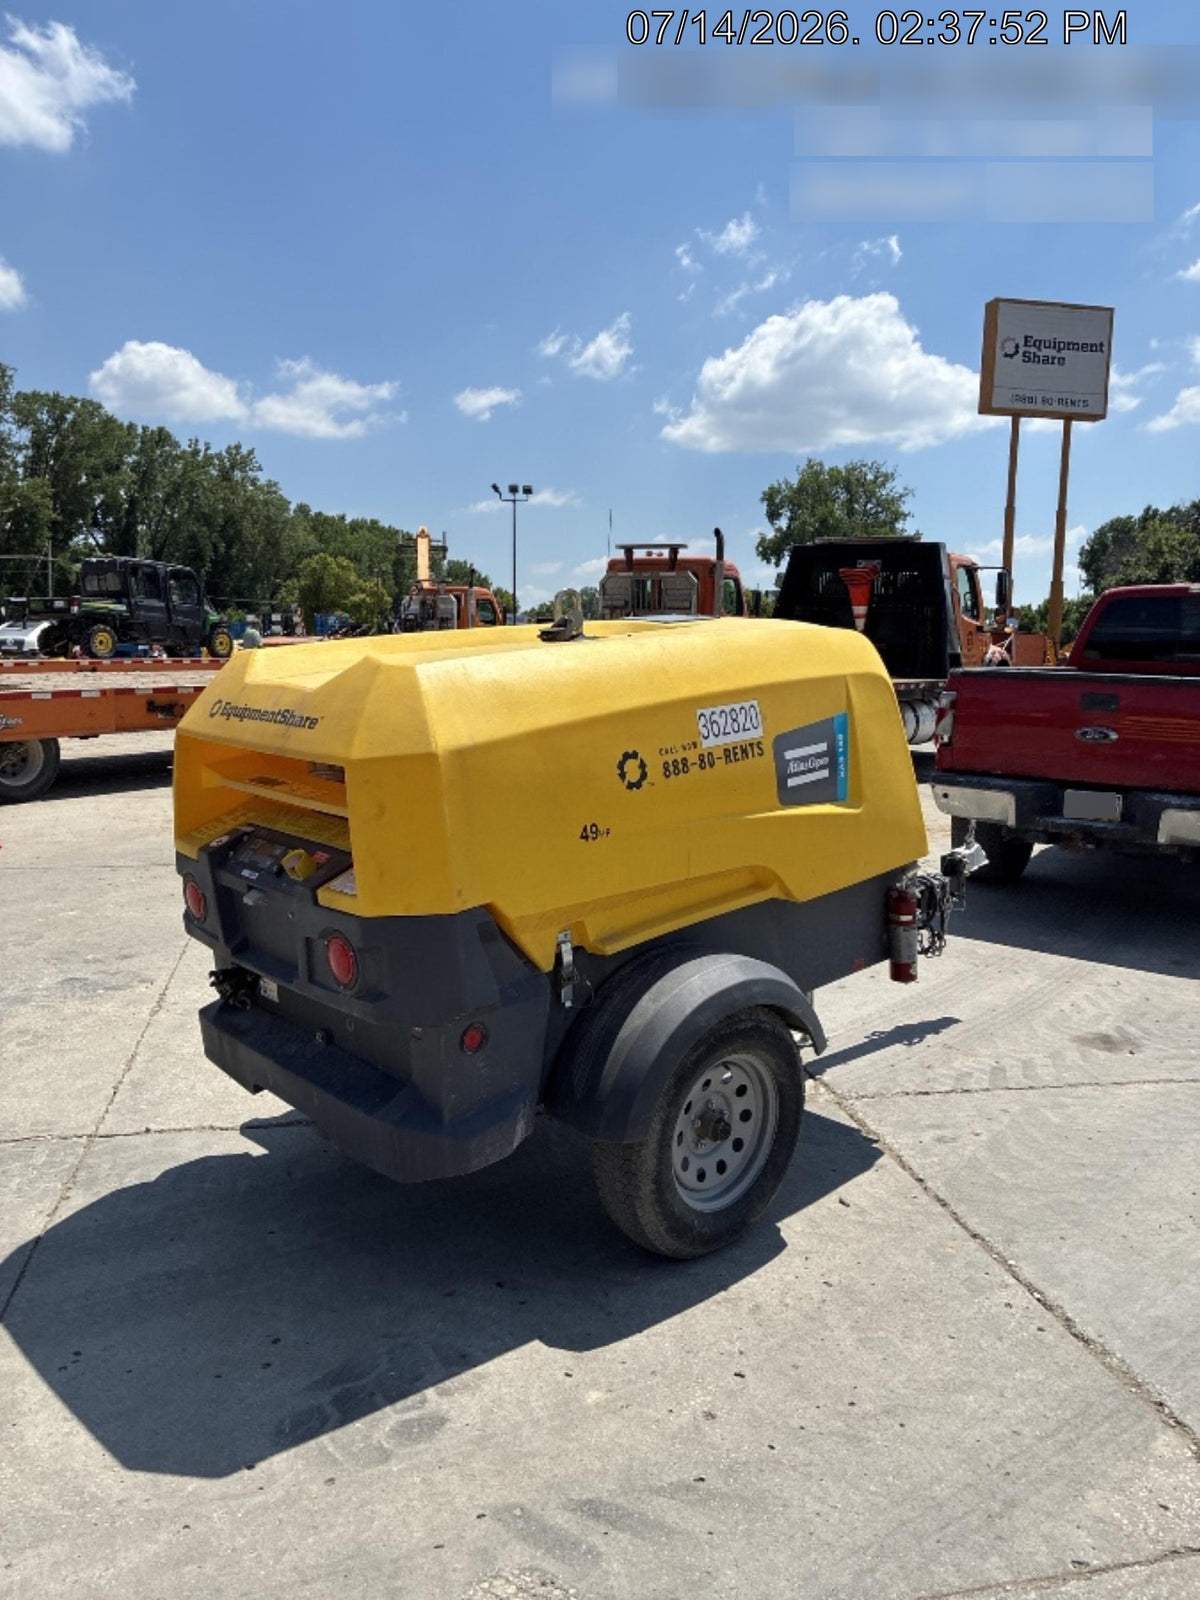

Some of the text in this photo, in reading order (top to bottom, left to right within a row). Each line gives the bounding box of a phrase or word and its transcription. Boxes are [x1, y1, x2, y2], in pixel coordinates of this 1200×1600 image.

[1021, 350, 1066, 366] Share
[1022, 335, 1105, 353] Equipment
[220, 701, 319, 730] EquipmentShare
[698, 704, 760, 740] 362820
[662, 740, 765, 779] 888-80-RENTS
